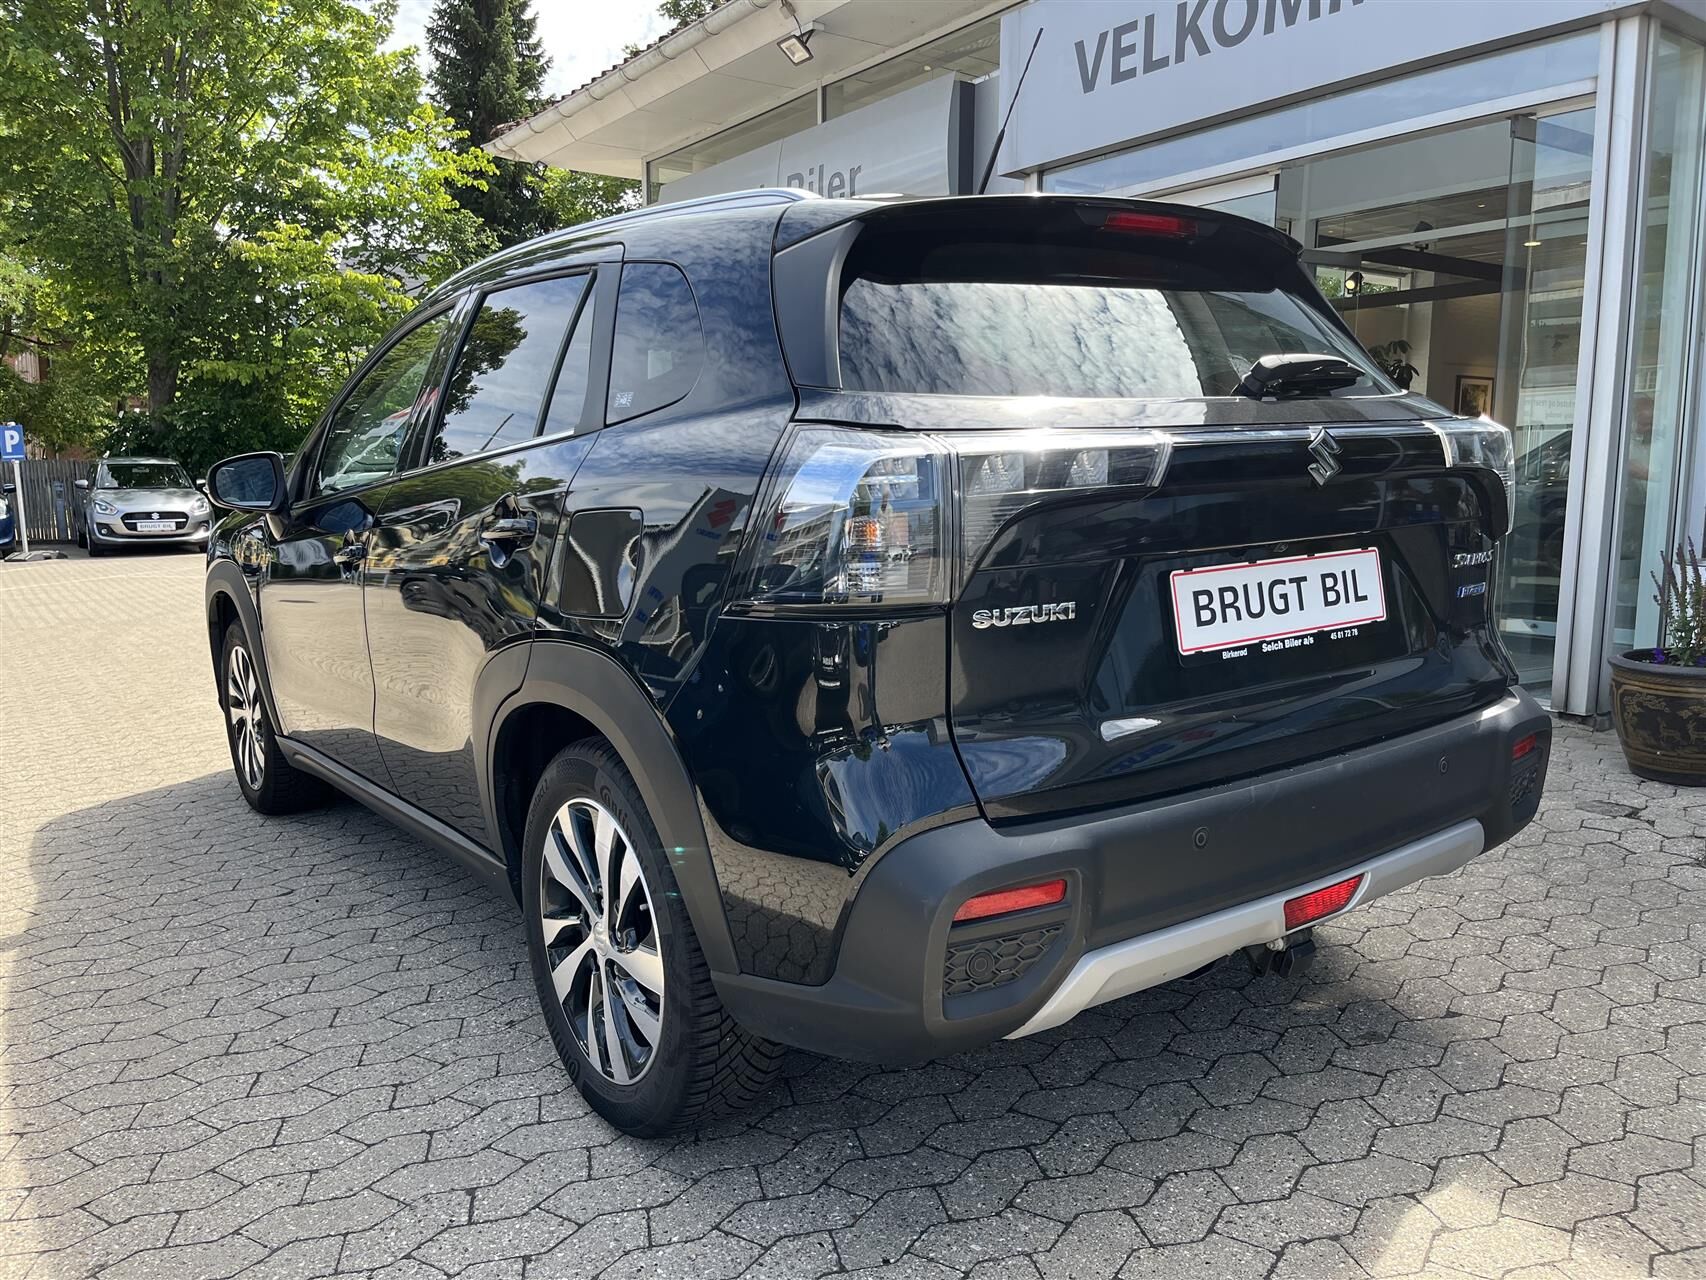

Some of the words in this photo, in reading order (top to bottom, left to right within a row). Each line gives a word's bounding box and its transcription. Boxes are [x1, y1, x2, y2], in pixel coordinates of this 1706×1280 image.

[1074, 0, 1364, 94] VELKO
[4, 430, 20, 453] P
[1192, 576, 1308, 627] BRUGT
[1320, 569, 1368, 607] BIL
[972, 601, 1076, 629] SUZUKI
[1284, 638, 1302, 648] Biler
[1303, 636, 1314, 645] a/s
